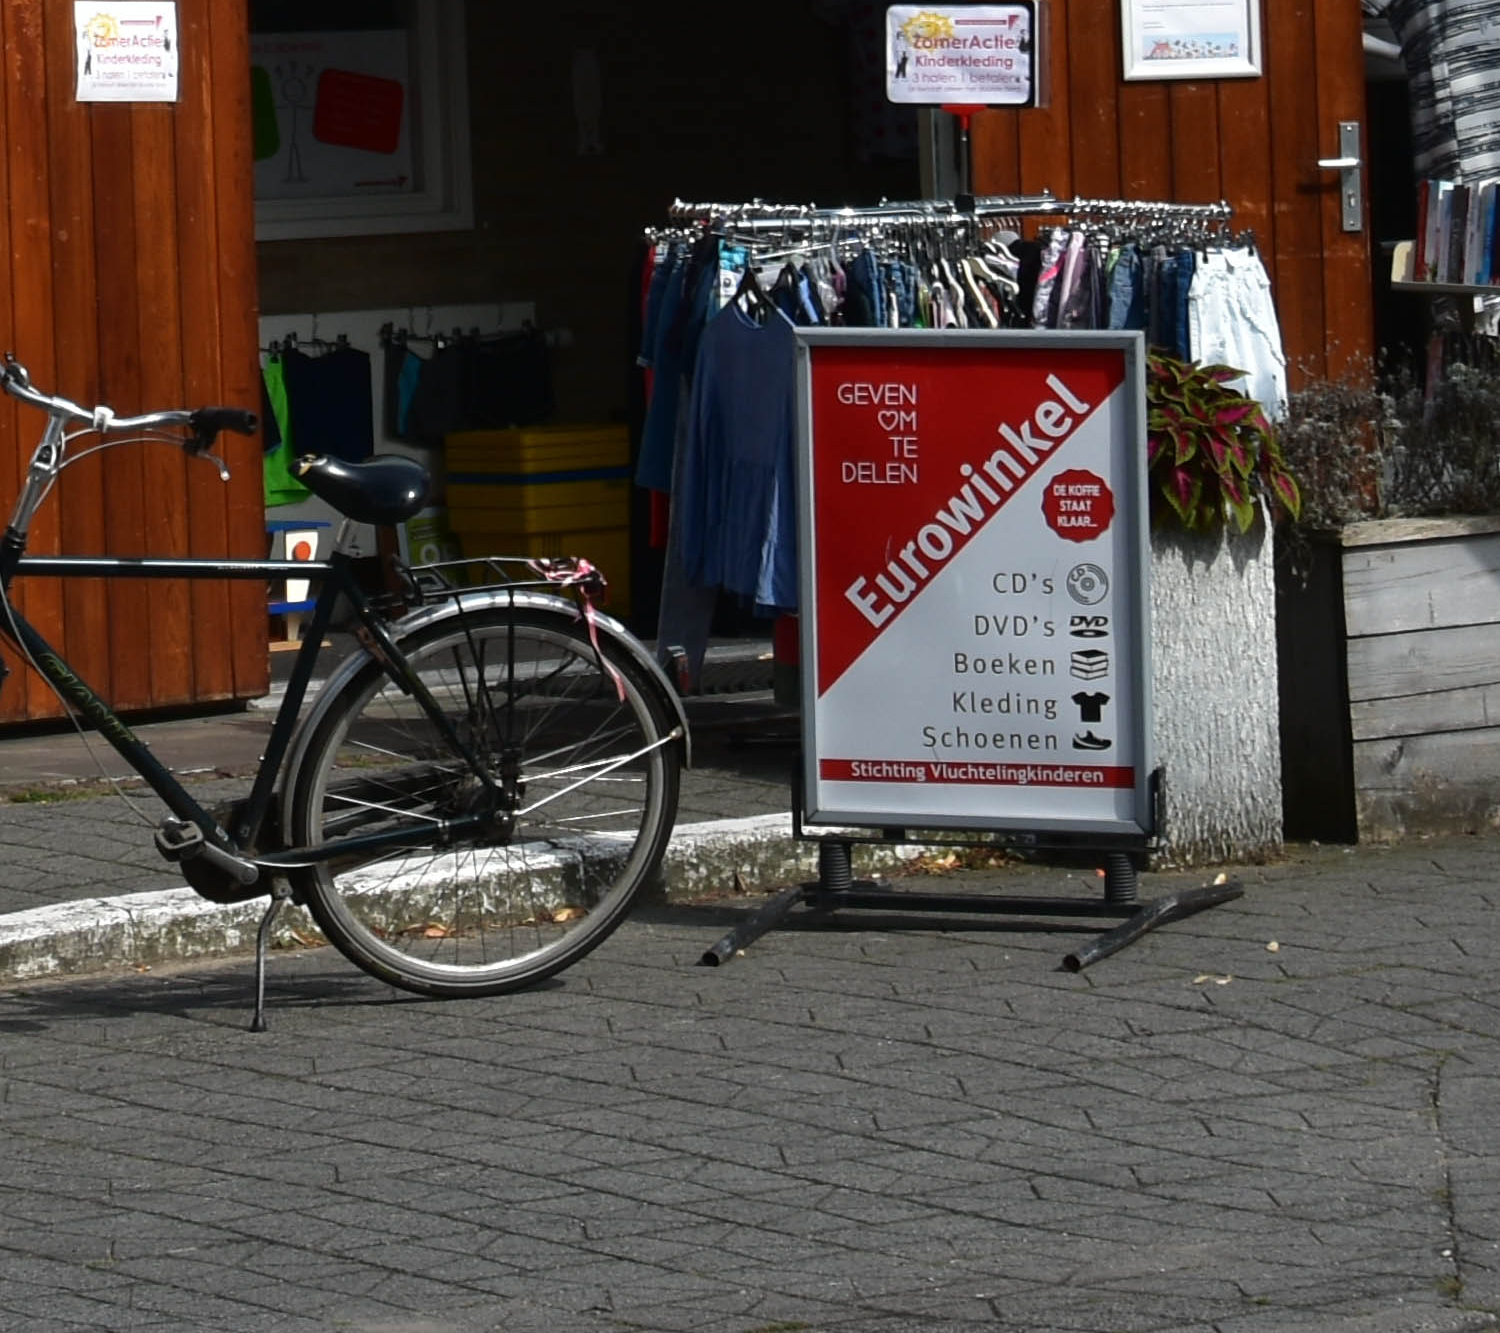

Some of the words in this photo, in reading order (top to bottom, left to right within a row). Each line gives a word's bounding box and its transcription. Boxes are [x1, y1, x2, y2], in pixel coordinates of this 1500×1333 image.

[915, 55, 1013, 70] Kinderkleding
[837, 383, 917, 405] GEVEN
[889, 437, 918, 458] TE
[841, 462, 918, 485] DELEN
[844, 374, 1090, 628] Eurowinkel
[1053, 485, 1066, 496] DE
[1068, 485, 1101, 496] KOFFIE
[1059, 500, 1091, 512] STAAT
[993, 573, 1054, 595] CD's
[973, 615, 1055, 638] DVD's
[1070, 616, 1108, 628] DVD
[954, 652, 1055, 676] Boeken
[952, 691, 1058, 720] Kleding
[923, 726, 1058, 750] Schoenen
[850, 760, 926, 781] Stichting
[930, 762, 1104, 784] Vluchtelingkinderen
